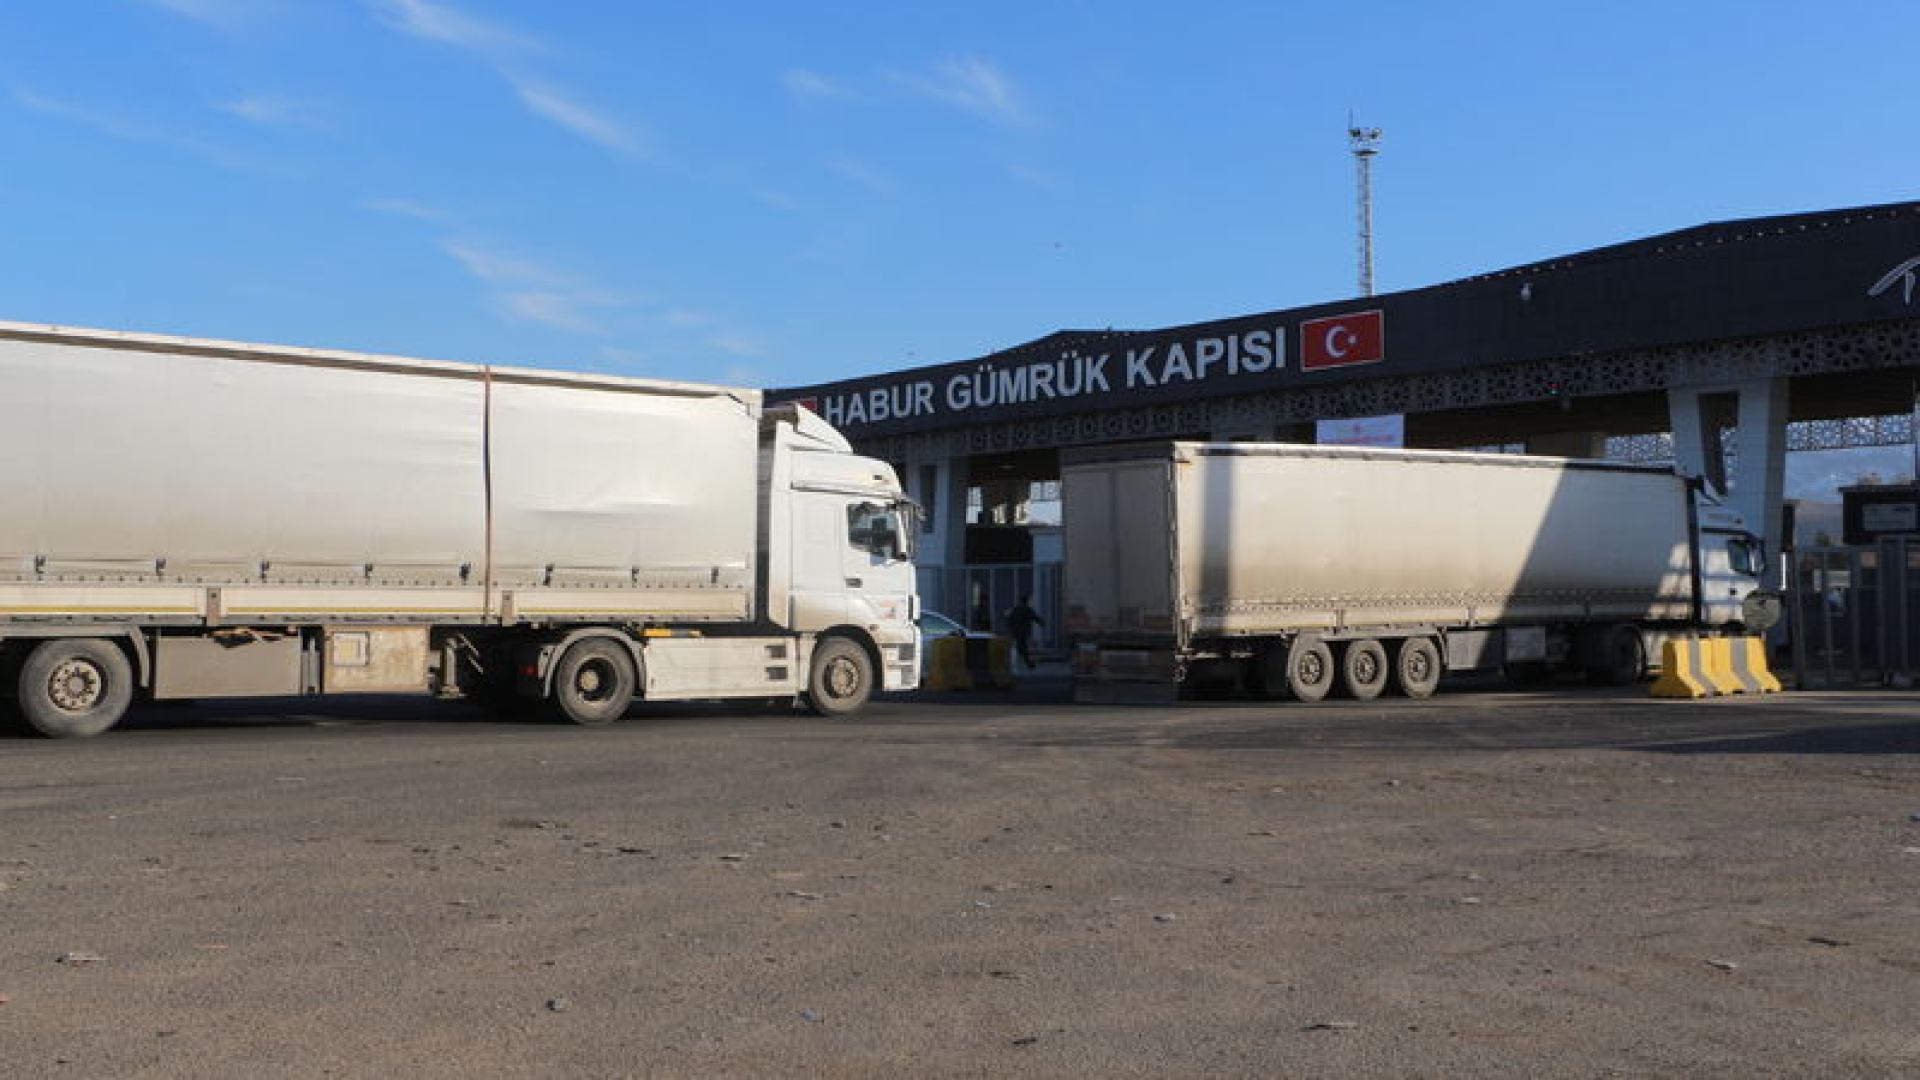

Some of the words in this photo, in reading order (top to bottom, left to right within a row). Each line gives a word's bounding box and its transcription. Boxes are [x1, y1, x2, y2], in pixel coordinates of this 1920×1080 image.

[825, 382, 934, 427] HABUR
[946, 350, 1111, 411] GÜMRÜK
[1126, 325, 1287, 389] KAPISI
